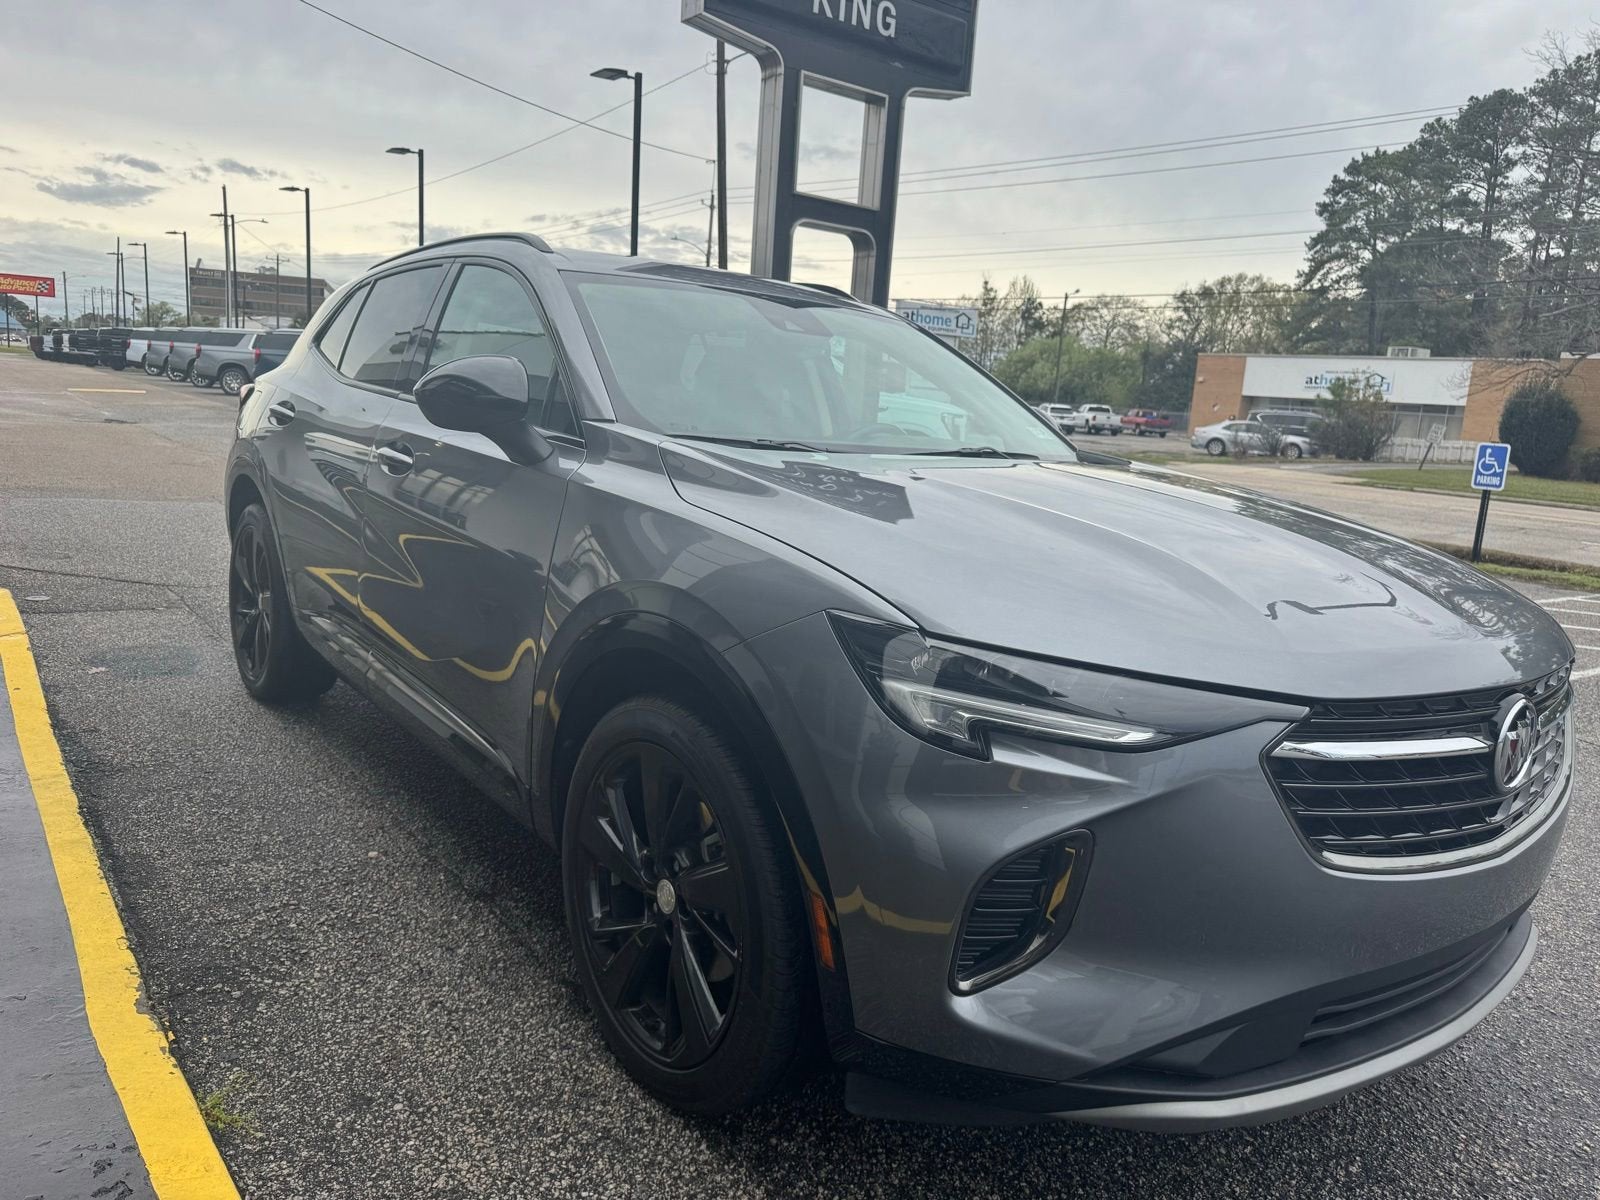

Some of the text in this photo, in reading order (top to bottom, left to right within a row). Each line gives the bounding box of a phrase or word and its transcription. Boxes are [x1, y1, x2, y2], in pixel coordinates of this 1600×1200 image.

[902, 309, 952, 327] athome
[928, 326, 957, 334] EQUIPMENT
[1476, 475, 1500, 486] PARKING
